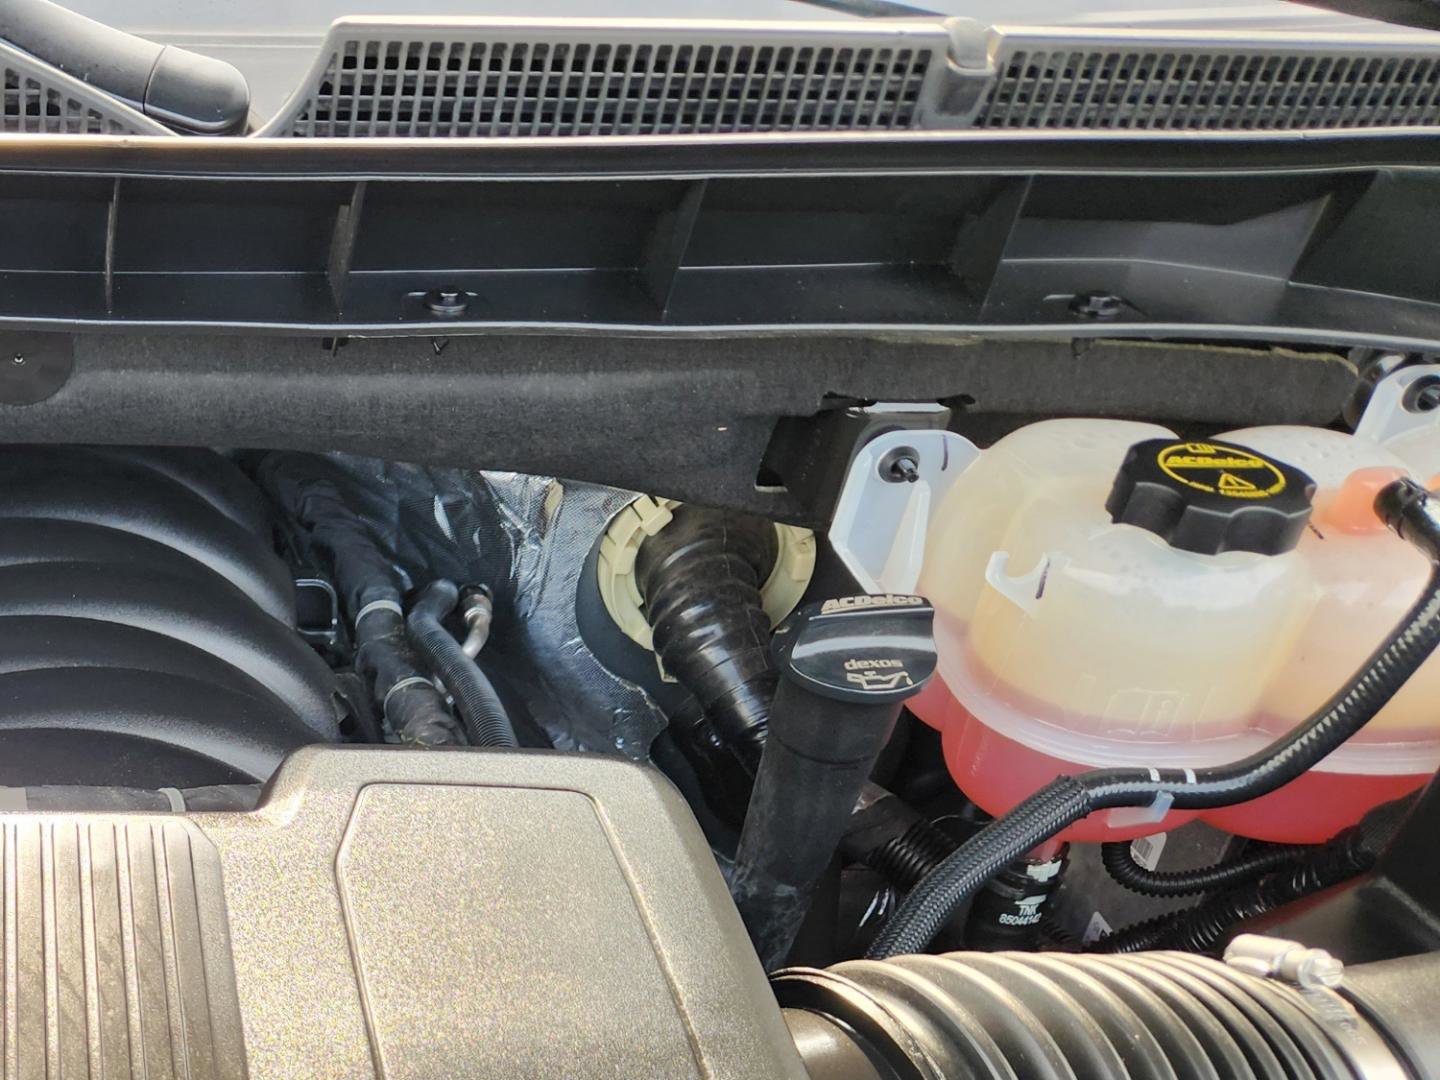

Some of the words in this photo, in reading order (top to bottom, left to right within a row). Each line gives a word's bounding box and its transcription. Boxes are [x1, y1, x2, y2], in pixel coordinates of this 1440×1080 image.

[1165, 456, 1265, 468] ACDelco
[821, 594, 923, 614] ACDelco
[844, 659, 903, 670] dexos
